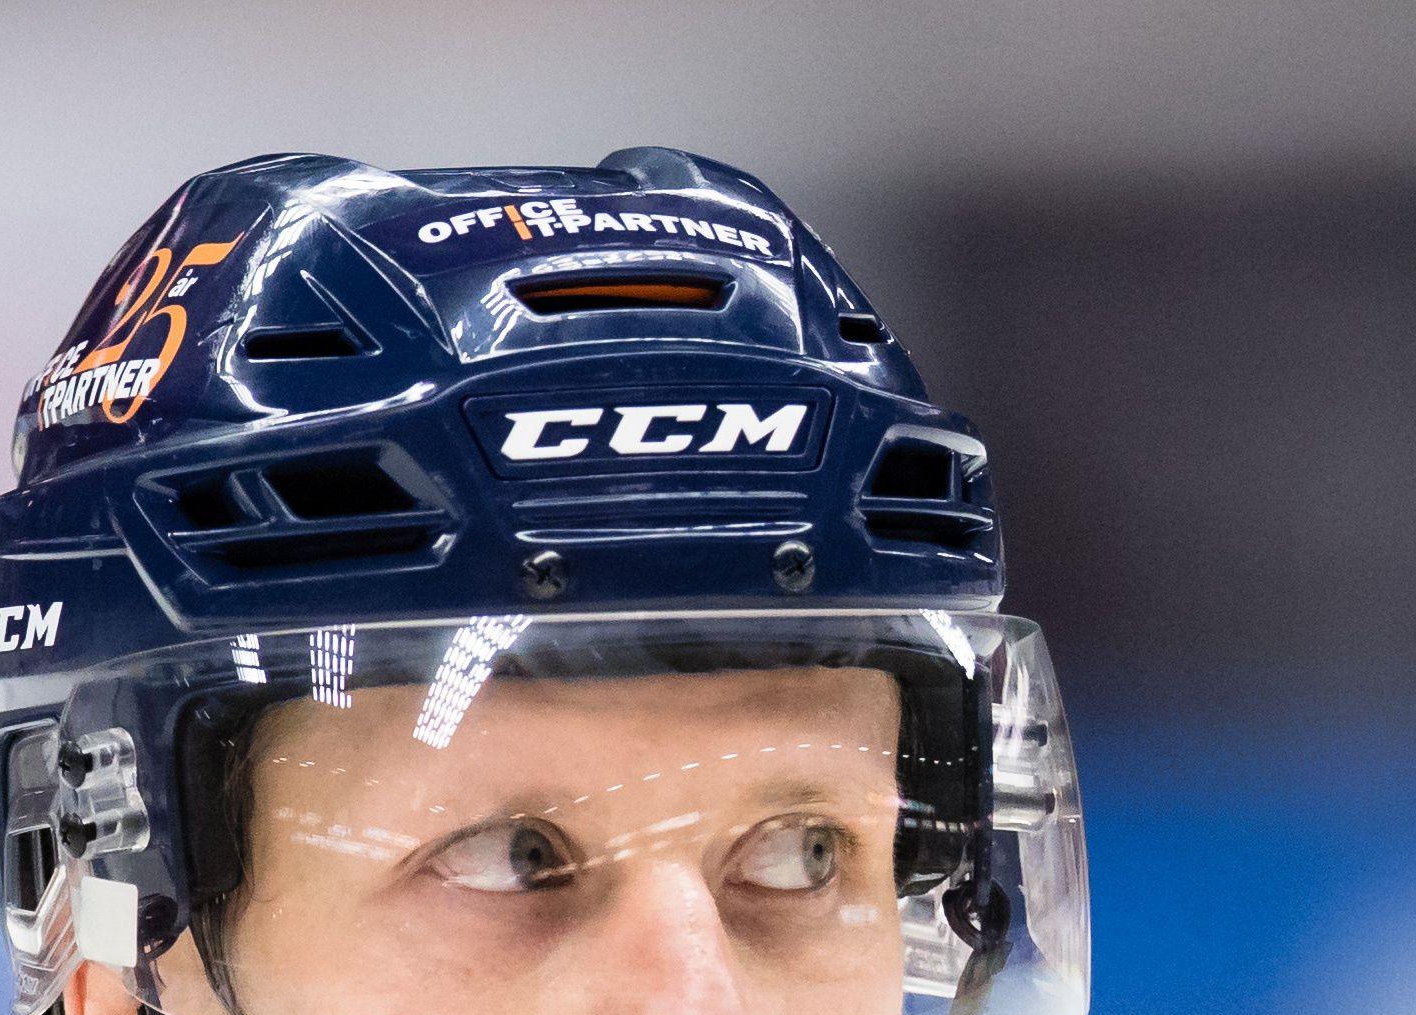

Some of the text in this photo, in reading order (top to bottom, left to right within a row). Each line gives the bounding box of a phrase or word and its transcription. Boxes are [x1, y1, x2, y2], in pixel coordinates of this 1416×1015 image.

[417, 198, 585, 244] OFFICE
[71, 231, 245, 424] 25 år
[500, 404, 808, 460] CCM
